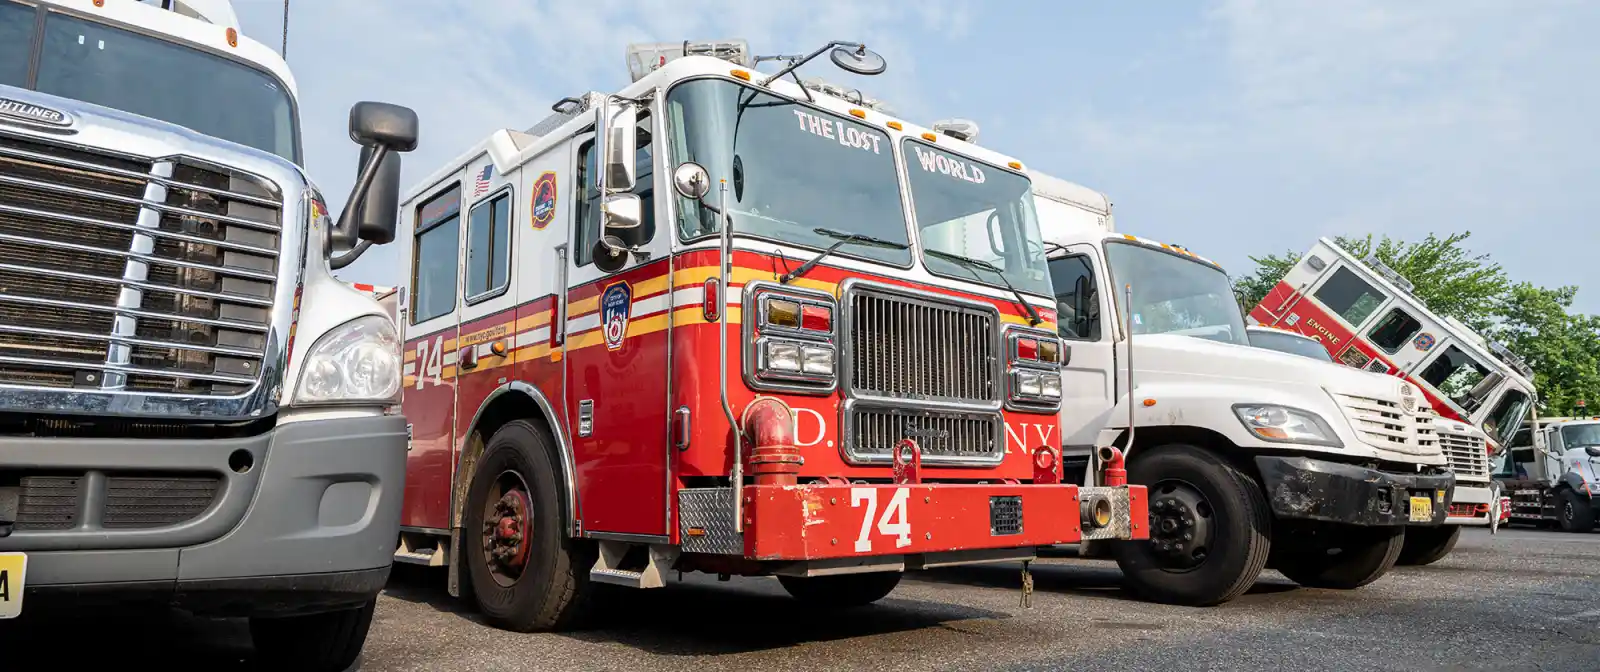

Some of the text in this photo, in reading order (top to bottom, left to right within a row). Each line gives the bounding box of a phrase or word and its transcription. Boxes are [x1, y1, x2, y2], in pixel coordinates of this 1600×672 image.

[0, 100, 61, 121] HTLINER
[794, 110, 985, 183] THE LOST WORLD
[1306, 318, 1340, 344] ENGINE
[417, 336, 442, 390] 74
[850, 487, 912, 553] 74
